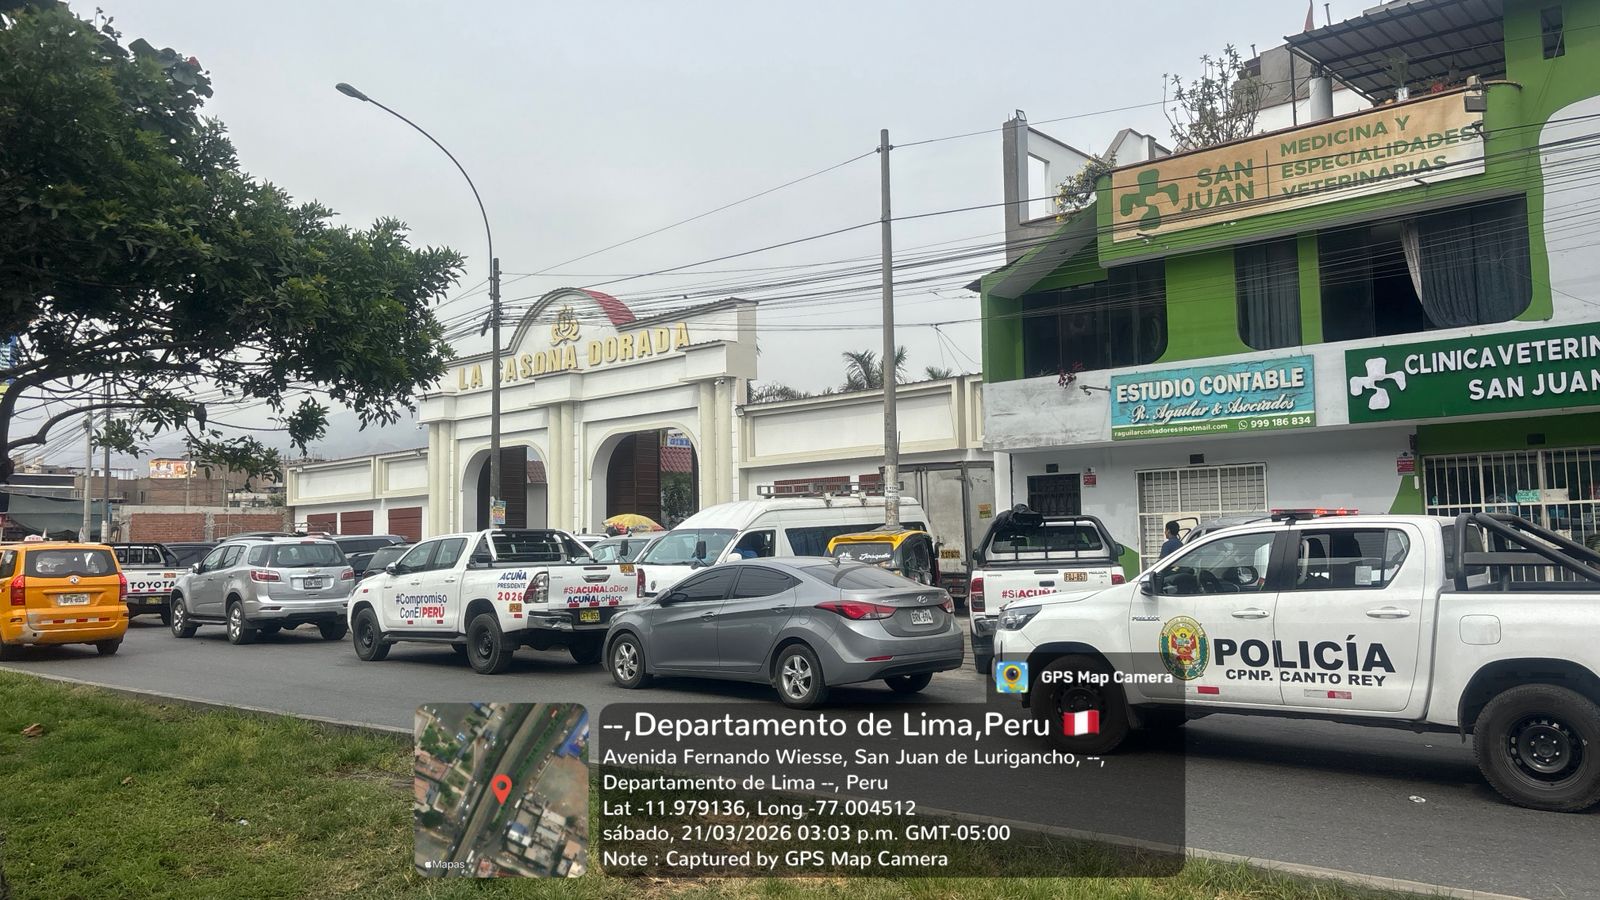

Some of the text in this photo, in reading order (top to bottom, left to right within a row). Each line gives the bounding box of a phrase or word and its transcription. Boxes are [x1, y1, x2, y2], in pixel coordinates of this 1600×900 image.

[1280, 115, 1410, 157] MEDICINA Y
[1281, 126, 1479, 179] ESPECIALIDADES
[1196, 159, 1254, 187] SAN
[1281, 155, 1448, 197] VETERINARIAS
[1181, 181, 1255, 212] JUAN
[458, 322, 691, 390] LA ASONA DORADA
[1404, 347, 1497, 375] CLINICA
[1116, 367, 1305, 403] ESTUDIO CONTABLE
[1468, 369, 1600, 400] SAN JUAN
[1131, 393, 1295, 425] R. Aguilar & Asociados
[1250, 416, 1311, 429] 999 186 834
[1114, 423, 1228, 438] raguilarcontadores@hotmail.com
[130, 581, 176, 589] TOYOTA
[499, 569, 527, 580] ACUÑA
[395, 592, 448, 606] #Compromiso
[497, 591, 523, 601] 2026
[567, 593, 623, 604] ACUÑALoHace
[1213, 634, 1396, 673] POLICÍA
[1225, 669, 1386, 687] CPNP. CANTO REY
